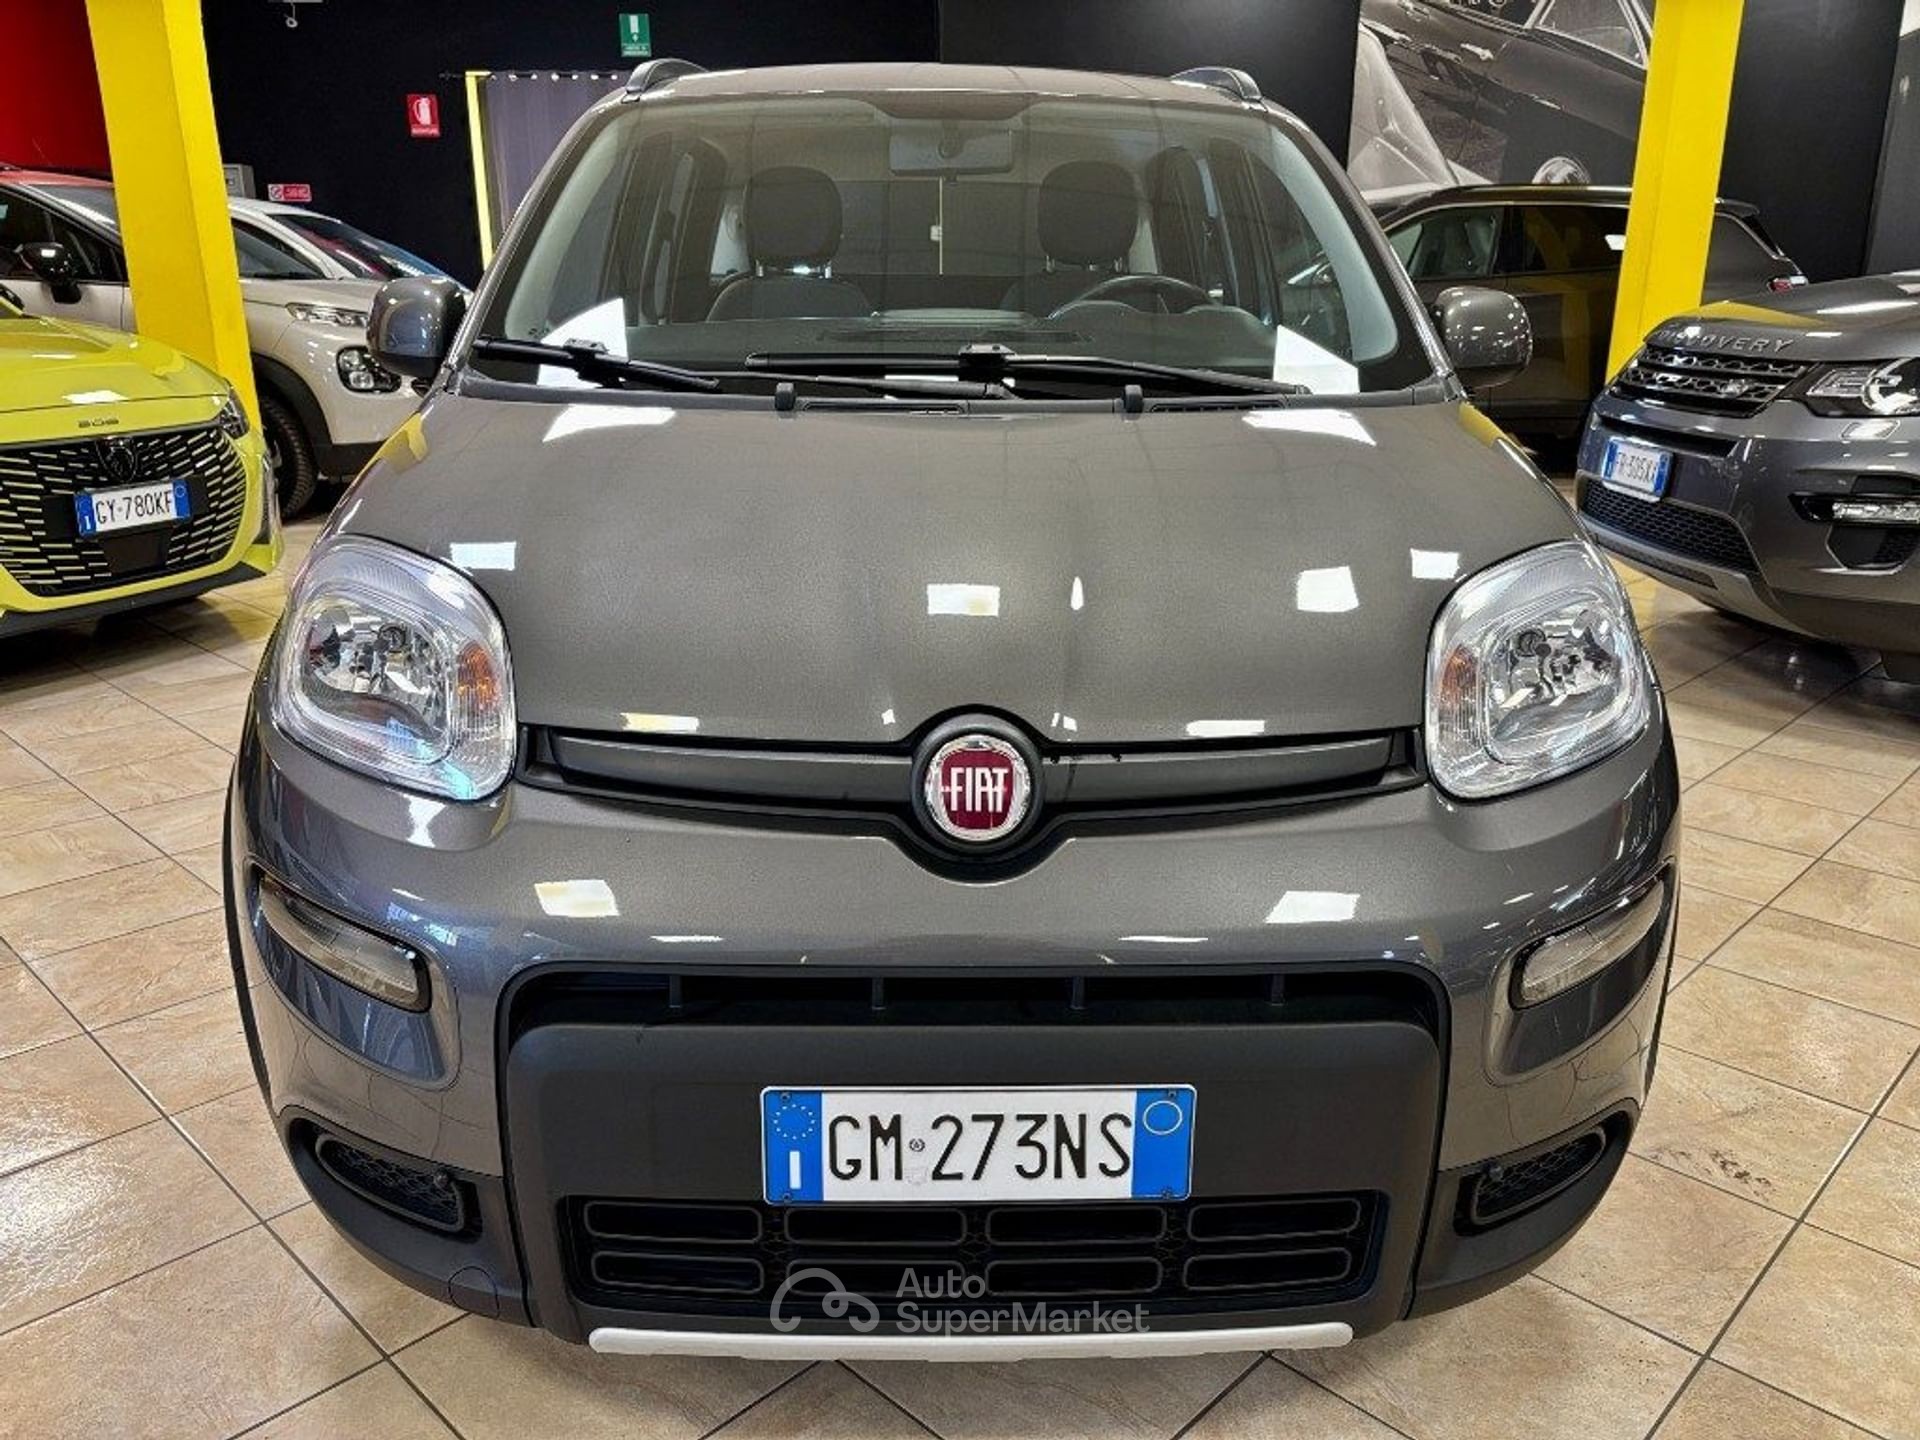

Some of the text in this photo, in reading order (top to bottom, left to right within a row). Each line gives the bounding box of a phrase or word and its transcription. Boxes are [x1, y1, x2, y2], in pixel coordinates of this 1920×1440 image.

[95, 499, 116, 524] GY
[122, 490, 172, 520] 780KF
[950, 766, 1009, 813] FIAT
[828, 1113, 903, 1181] GM
[931, 1112, 1133, 1181] 273NS
